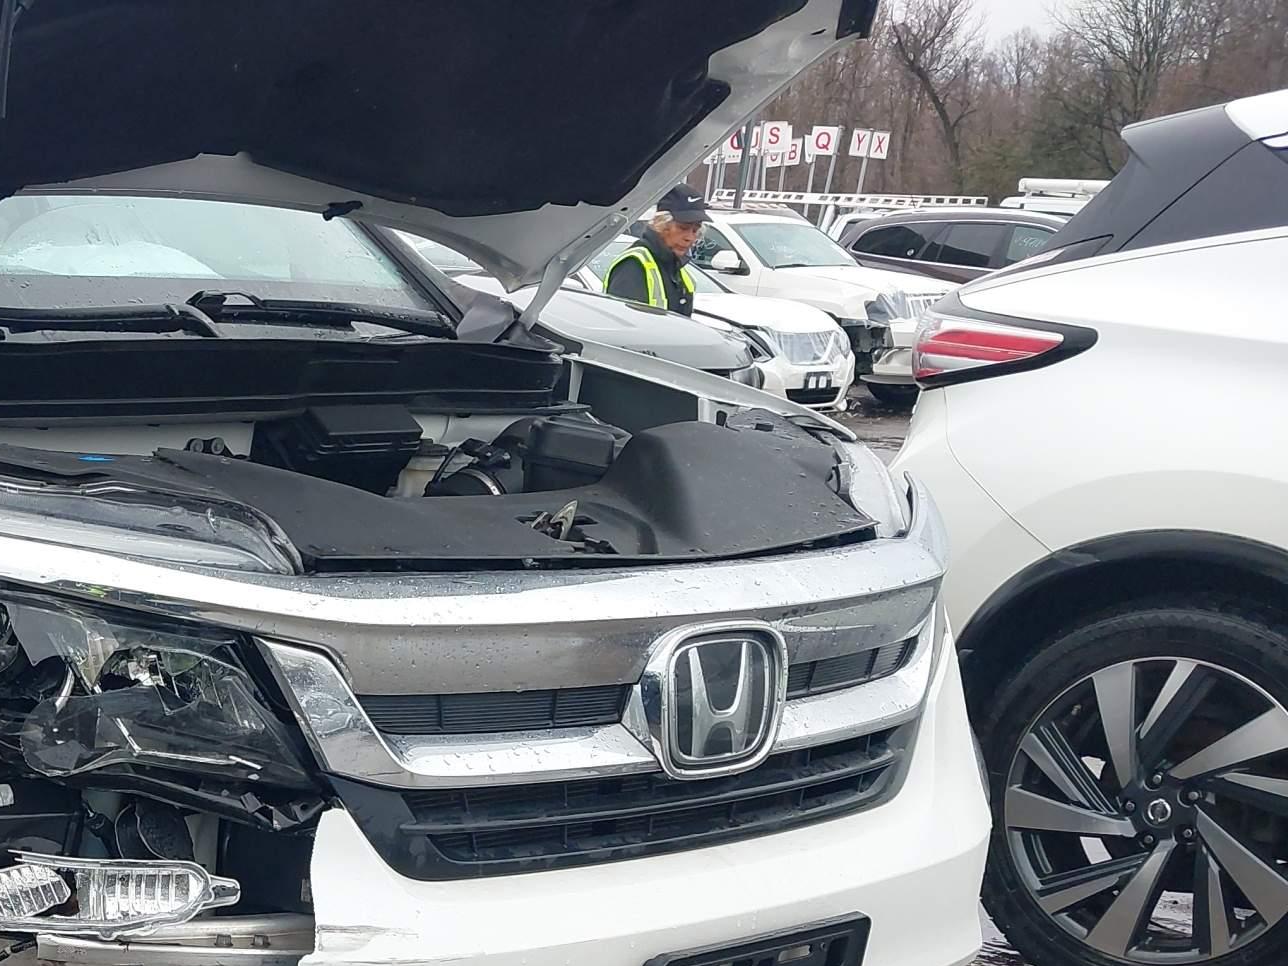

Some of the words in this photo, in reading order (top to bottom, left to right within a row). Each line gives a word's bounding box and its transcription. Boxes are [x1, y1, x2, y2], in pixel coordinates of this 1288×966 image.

[768, 127, 780, 145] S
[815, 131, 830, 151] Q
[856, 133, 866, 151] Y
[874, 135, 885, 153] X
